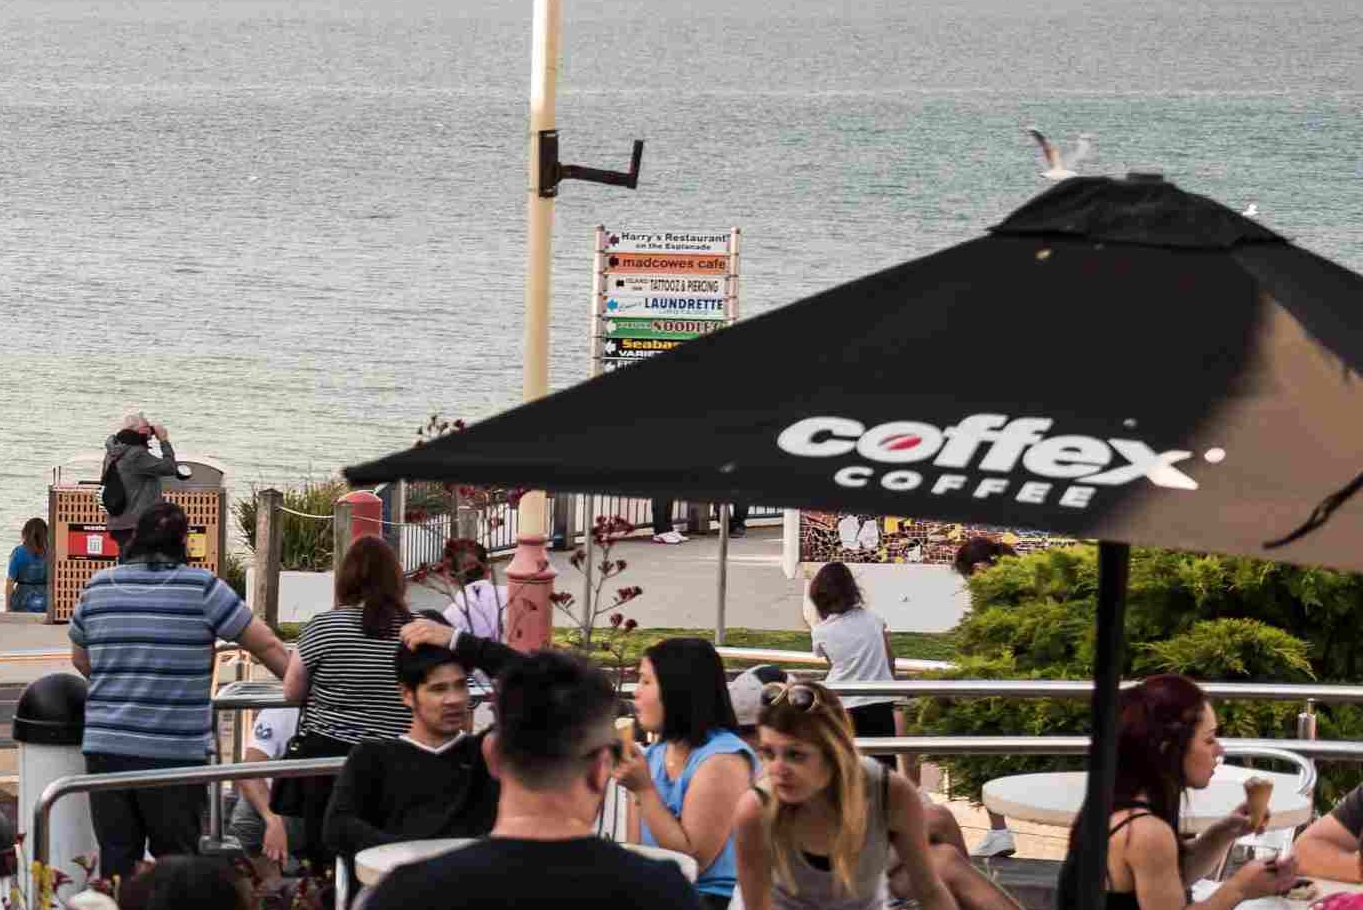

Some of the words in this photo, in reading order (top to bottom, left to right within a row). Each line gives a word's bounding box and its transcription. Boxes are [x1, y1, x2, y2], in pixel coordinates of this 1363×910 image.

[621, 232, 662, 242] Harry's
[665, 233, 727, 243] Restaurant
[622, 257, 694, 269] madcowes
[697, 258, 726, 270] cafe
[687, 280, 719, 293] PIERCING
[644, 297, 724, 311] LAUNDRETTE
[777, 413, 1199, 490] coffex
[834, 465, 1097, 508] COFFEE
